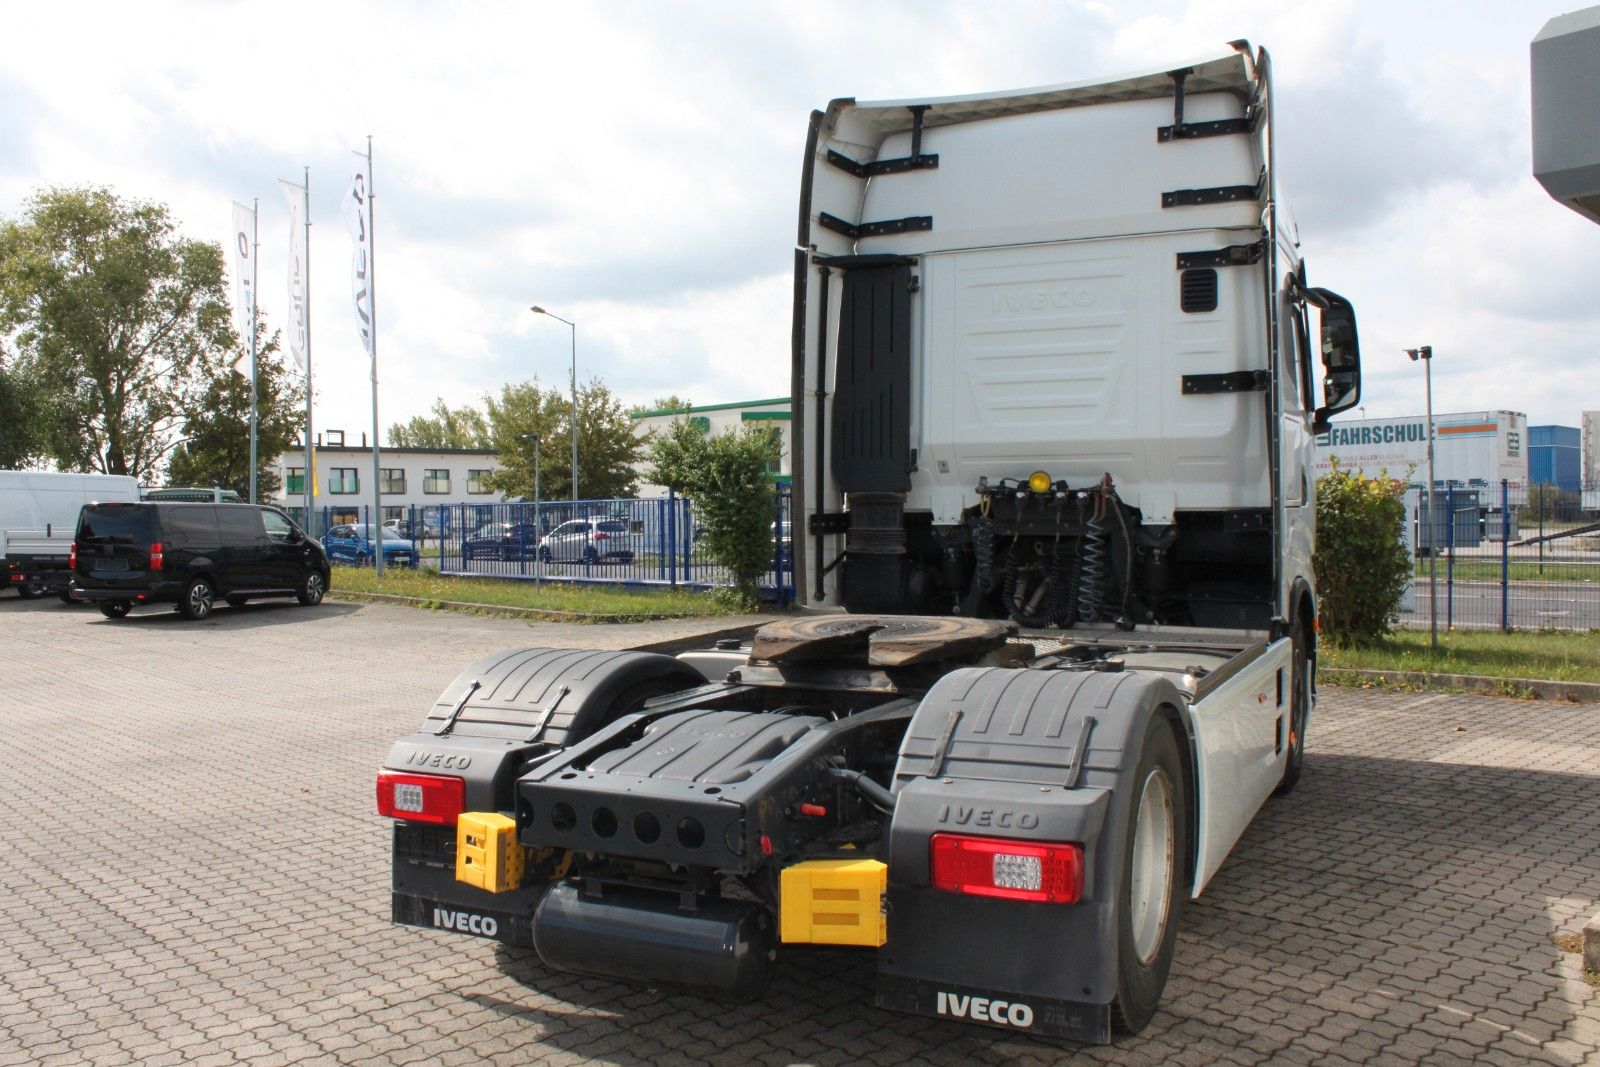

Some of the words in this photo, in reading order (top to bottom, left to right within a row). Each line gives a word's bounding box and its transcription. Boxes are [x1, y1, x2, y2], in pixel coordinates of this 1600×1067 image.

[990, 288, 1096, 313] IVECO
[406, 751, 472, 770] IVECO
[938, 804, 1040, 829] IVECO
[433, 908, 498, 936] IVECO
[937, 991, 1034, 1028] IVECO
